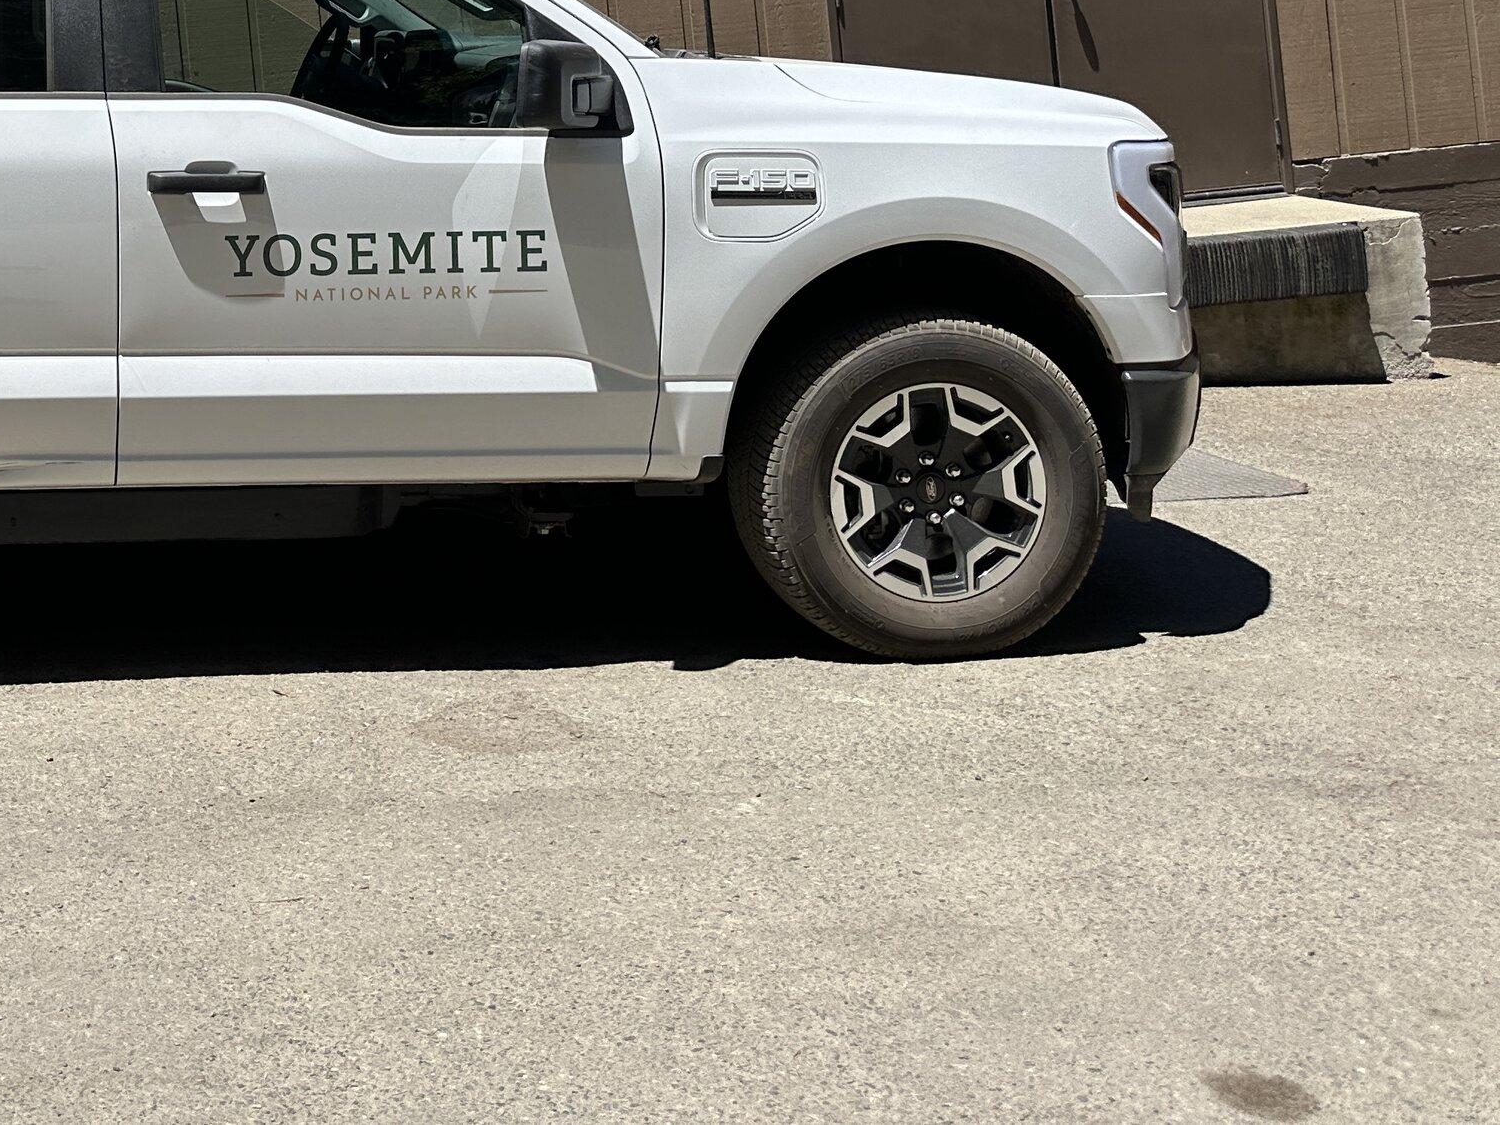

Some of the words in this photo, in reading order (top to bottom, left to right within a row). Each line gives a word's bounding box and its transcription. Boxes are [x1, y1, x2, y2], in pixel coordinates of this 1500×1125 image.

[709, 168, 816, 190] F-150
[224, 229, 548, 277] YOSEMITE
[295, 286, 410, 302] NATIONAL
[423, 285, 477, 300] PARK
